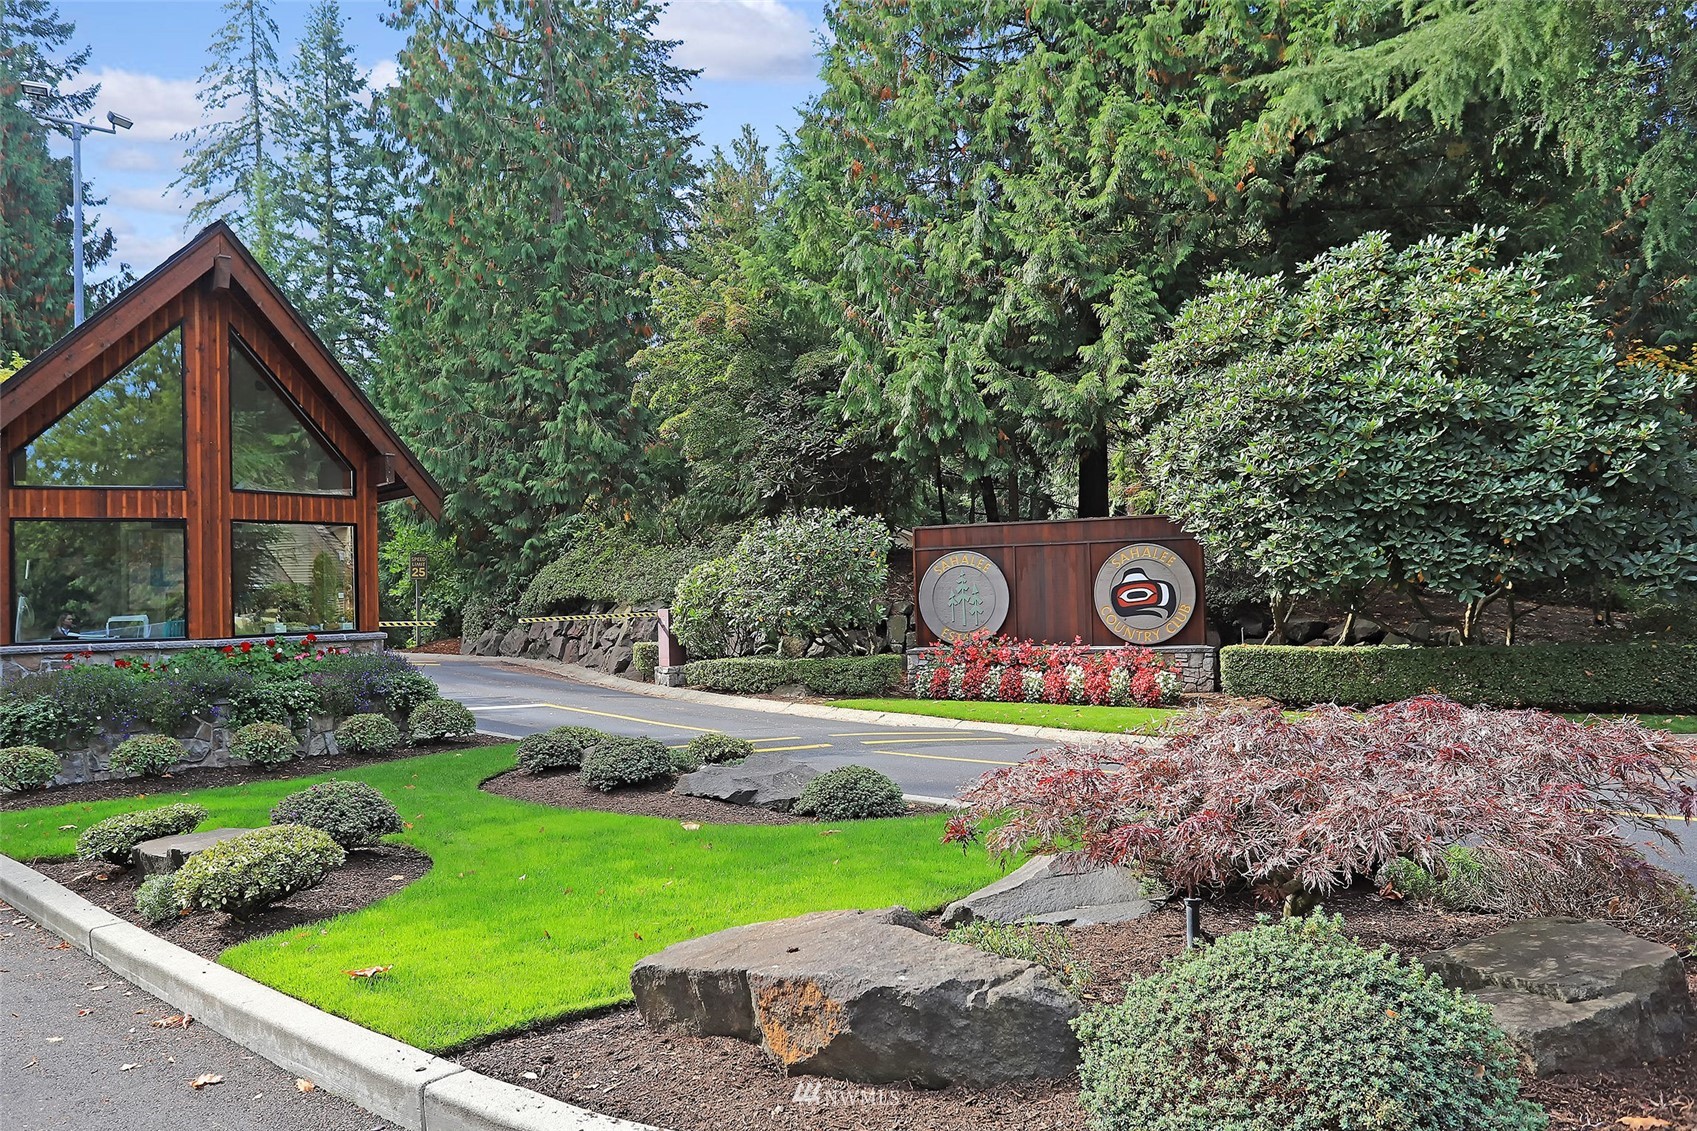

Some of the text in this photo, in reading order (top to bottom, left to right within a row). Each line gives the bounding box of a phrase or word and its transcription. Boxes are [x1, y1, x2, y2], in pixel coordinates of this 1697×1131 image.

[933, 554, 992, 576] SAHALEE
[1111, 546, 1177, 569] SAHALEE
[411, 567, 426, 577] 25
[1101, 604, 1192, 642] COUNTRY CLUB
